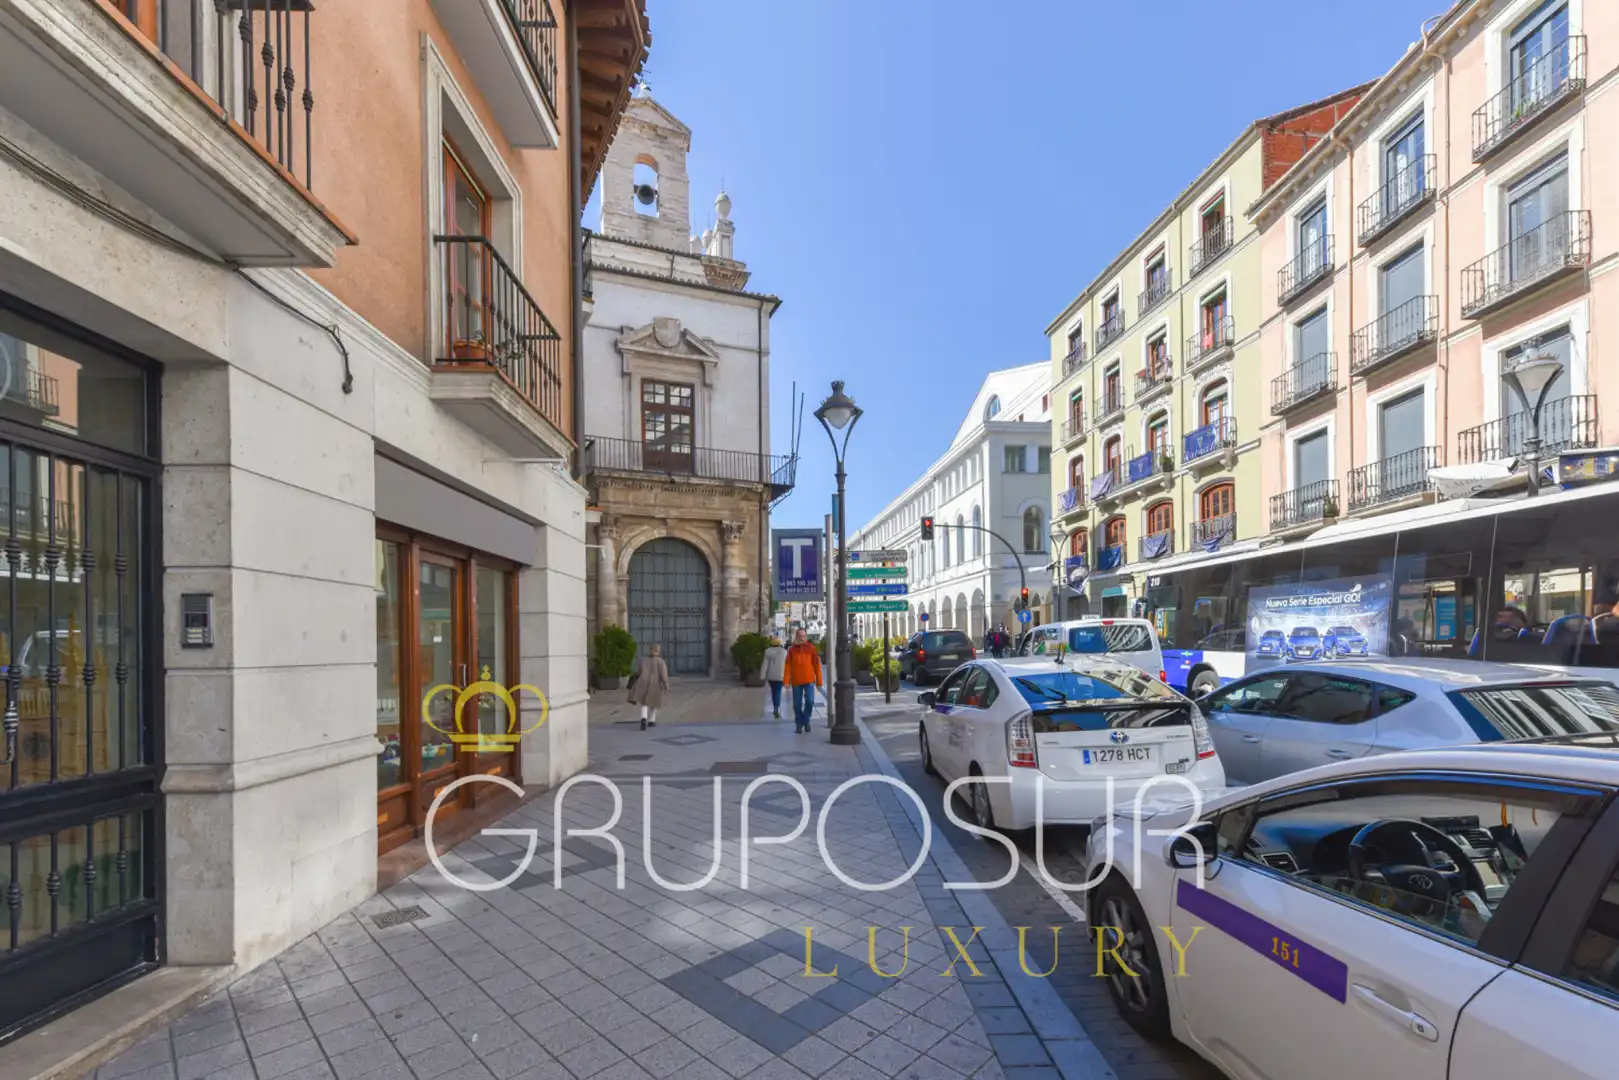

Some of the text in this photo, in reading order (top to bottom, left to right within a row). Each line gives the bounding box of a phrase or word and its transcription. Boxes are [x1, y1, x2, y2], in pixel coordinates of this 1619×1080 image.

[781, 538, 813, 579] T
[1288, 597, 1307, 607] Serie
[1308, 594, 1342, 605] Especial
[1343, 593, 1361, 603] GO!
[1093, 747, 1151, 763] 1278 HCT
[1271, 937, 1300, 969] 151
